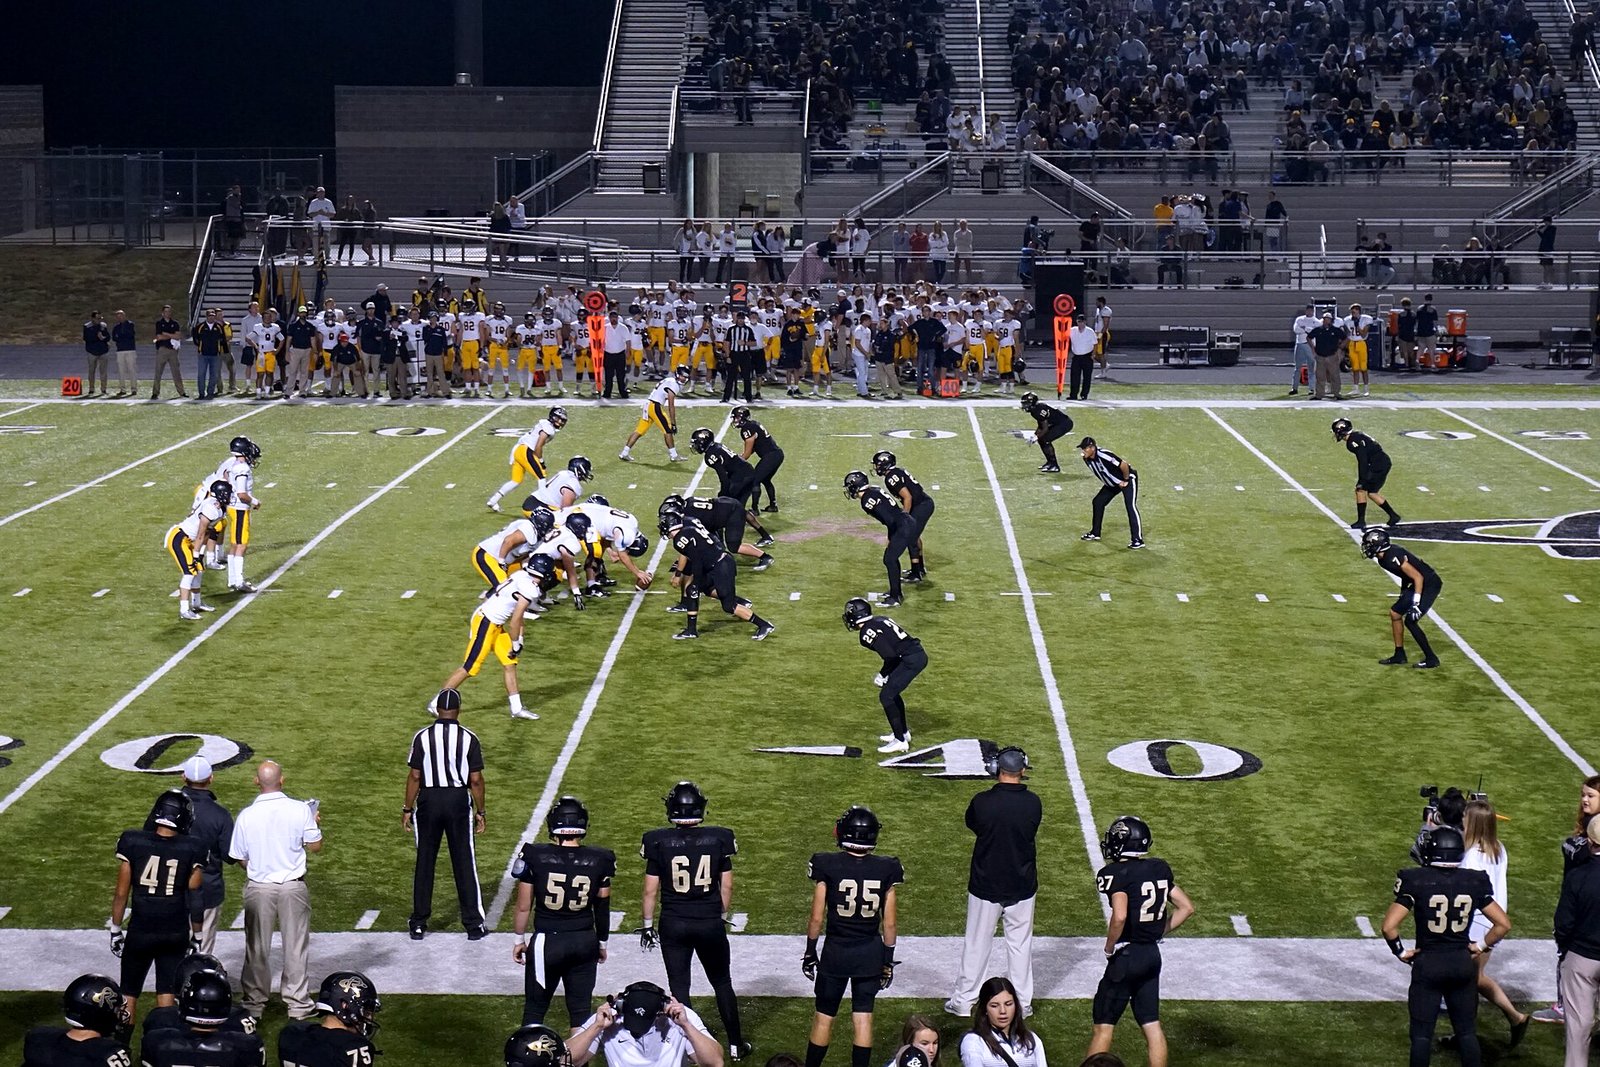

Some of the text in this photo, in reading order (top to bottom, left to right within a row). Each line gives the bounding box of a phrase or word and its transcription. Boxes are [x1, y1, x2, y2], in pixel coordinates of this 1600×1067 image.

[733, 283, 747, 301] 2
[765, 318, 777, 328] 96
[543, 329, 555, 339] 35
[577, 329, 590, 339] 56
[970, 327, 981, 338] 62
[63, 379, 80, 392] 20
[944, 380, 959, 394] 40
[742, 429, 752, 439] 21
[708, 454, 719, 465] 42
[865, 497, 877, 510] 50
[676, 536, 690, 549] 90
[862, 628, 877, 644] 29
[139, 855, 180, 896] 41
[671, 854, 713, 894] 64
[1097, 875, 1114, 892] 27
[544, 872, 592, 912] 53
[836, 878, 882, 918] 35
[1139, 879, 1169, 922] 27
[1427, 894, 1473, 934] 33
[106, 1049, 131, 1067] 65
[346, 1045, 372, 1067] 75
